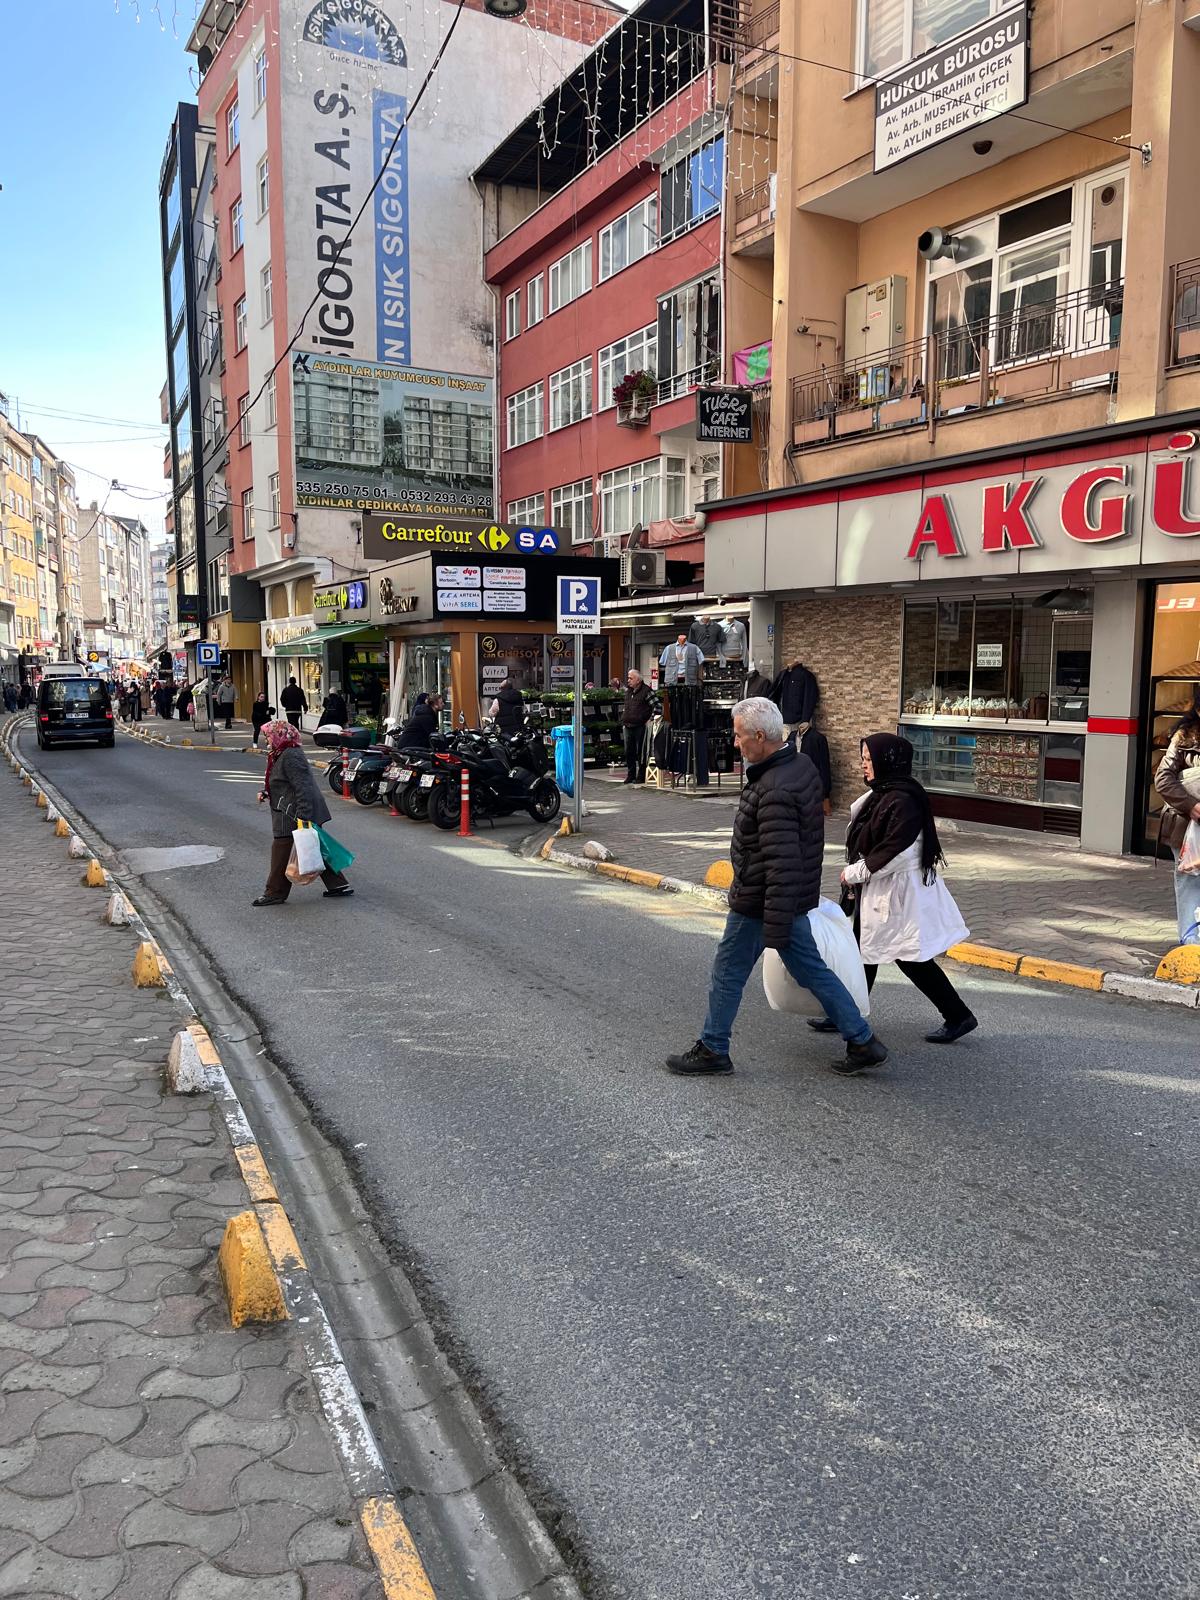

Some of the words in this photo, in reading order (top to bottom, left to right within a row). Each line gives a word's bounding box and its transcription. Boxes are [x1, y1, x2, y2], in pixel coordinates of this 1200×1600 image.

[880, 64, 939, 109] HUKUK
[944, 21, 1020, 73] BÜROSU
[885, 113, 898, 127] Av.
[901, 98, 929, 117] HALİL
[932, 72, 975, 103] İBRAHİM
[979, 53, 1012, 80] ÇİÇEK
[887, 128, 900, 141] Av.
[903, 119, 921, 134] Arb.
[924, 92, 971, 122] MUSTAFA
[888, 144, 901, 157] Av.
[903, 128, 932, 151] AYLİN
[935, 109, 970, 134] BENEK
[377, 107, 403, 256] SİGORTA
[383, 264, 406, 328] IŞIK
[313, 360, 372, 378] AYDINLAR
[374, 369, 446, 387] KUYUMCUSU
[448, 376, 486, 392] İNŞAAT
[703, 393, 748, 415] TUĞRA
[711, 412, 740, 426] CAFE
[325, 483, 349, 495] 250
[354, 486, 369, 497] 75
[373, 487, 388, 498] 01
[401, 489, 430, 502] 0532
[435, 492, 456, 503] 293
[460, 494, 474, 505] 43
[478, 496, 492, 507] 28
[357, 499, 423, 513] GEDİKKAYA
[426, 506, 488, 518] KONUTLARI
[382, 521, 473, 544] Carrefour
[519, 532, 557, 549] SA
[462, 568, 478, 576] dyo
[569, 581, 588, 612] P
[203, 648, 213, 660] D
